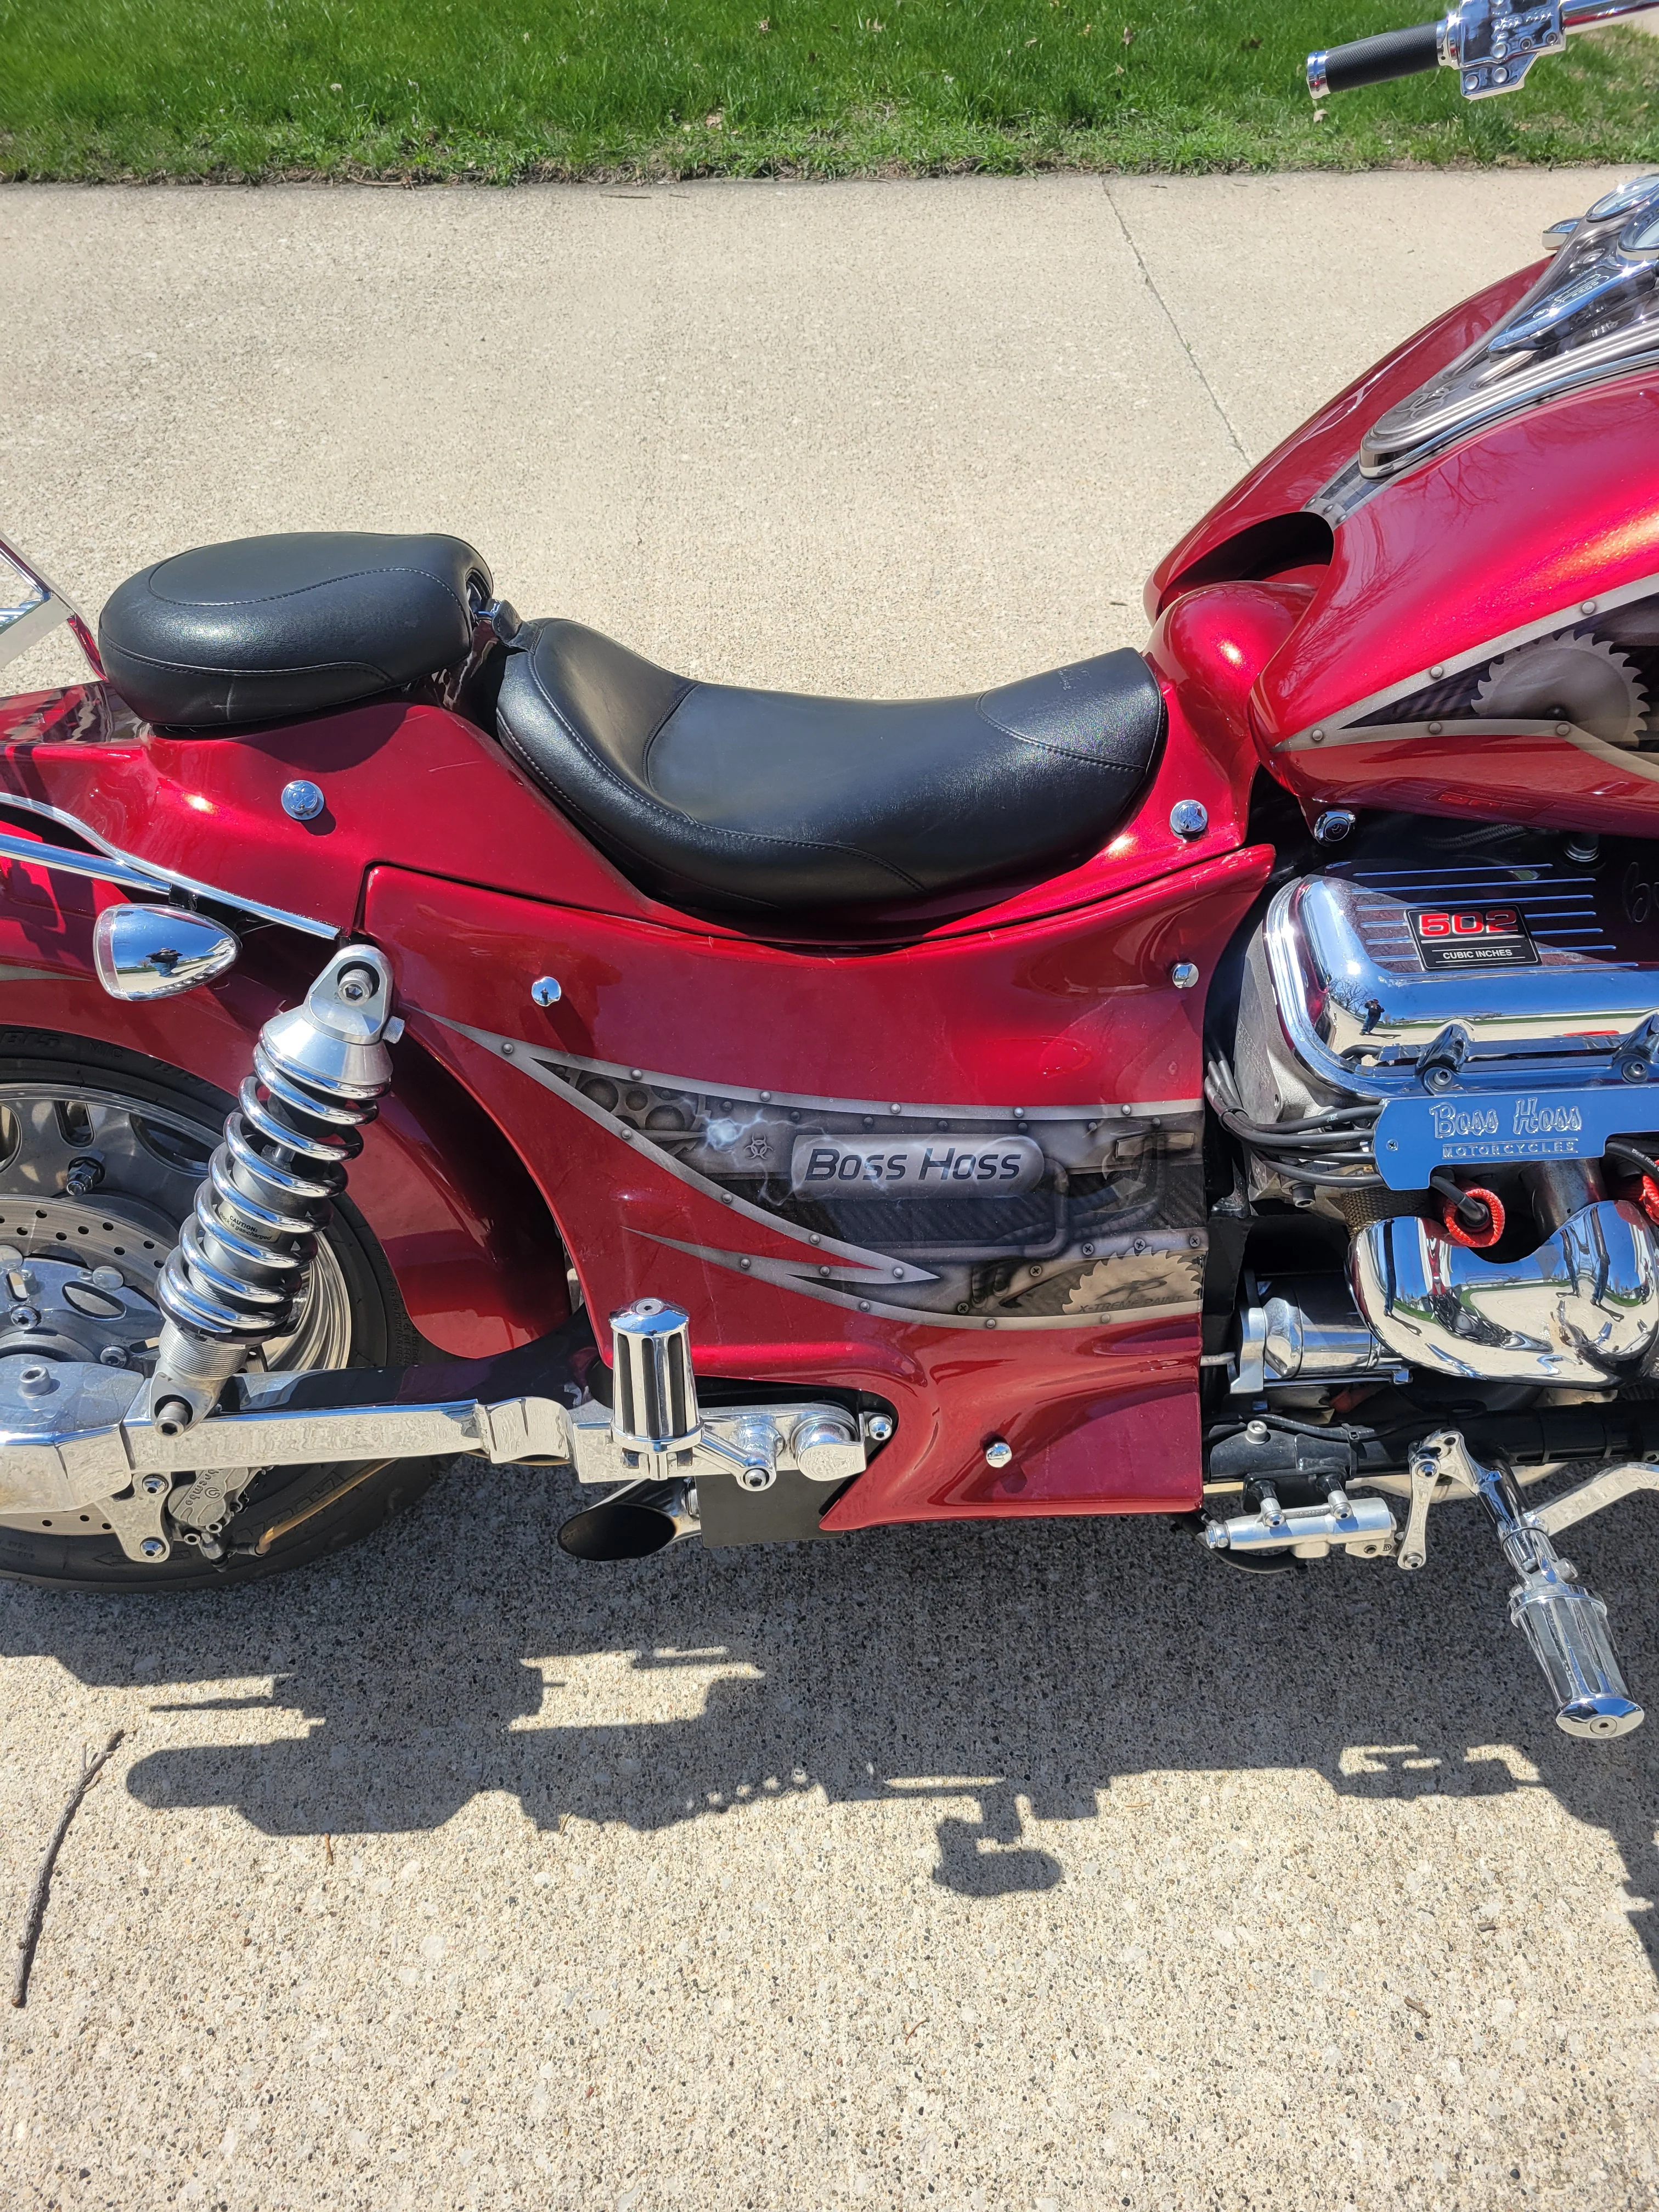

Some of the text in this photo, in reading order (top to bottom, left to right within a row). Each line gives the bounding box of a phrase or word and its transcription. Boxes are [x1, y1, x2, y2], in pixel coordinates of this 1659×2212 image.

[1419, 909, 1518, 936] 502
[1442, 949, 1513, 960] CUBIC INCHES
[1429, 1097, 1582, 1138] Boss Hoss
[1442, 1142, 1575, 1158] MOTORCYCLES
[1078, 1295, 1184, 1313] X-TREME PAINT
